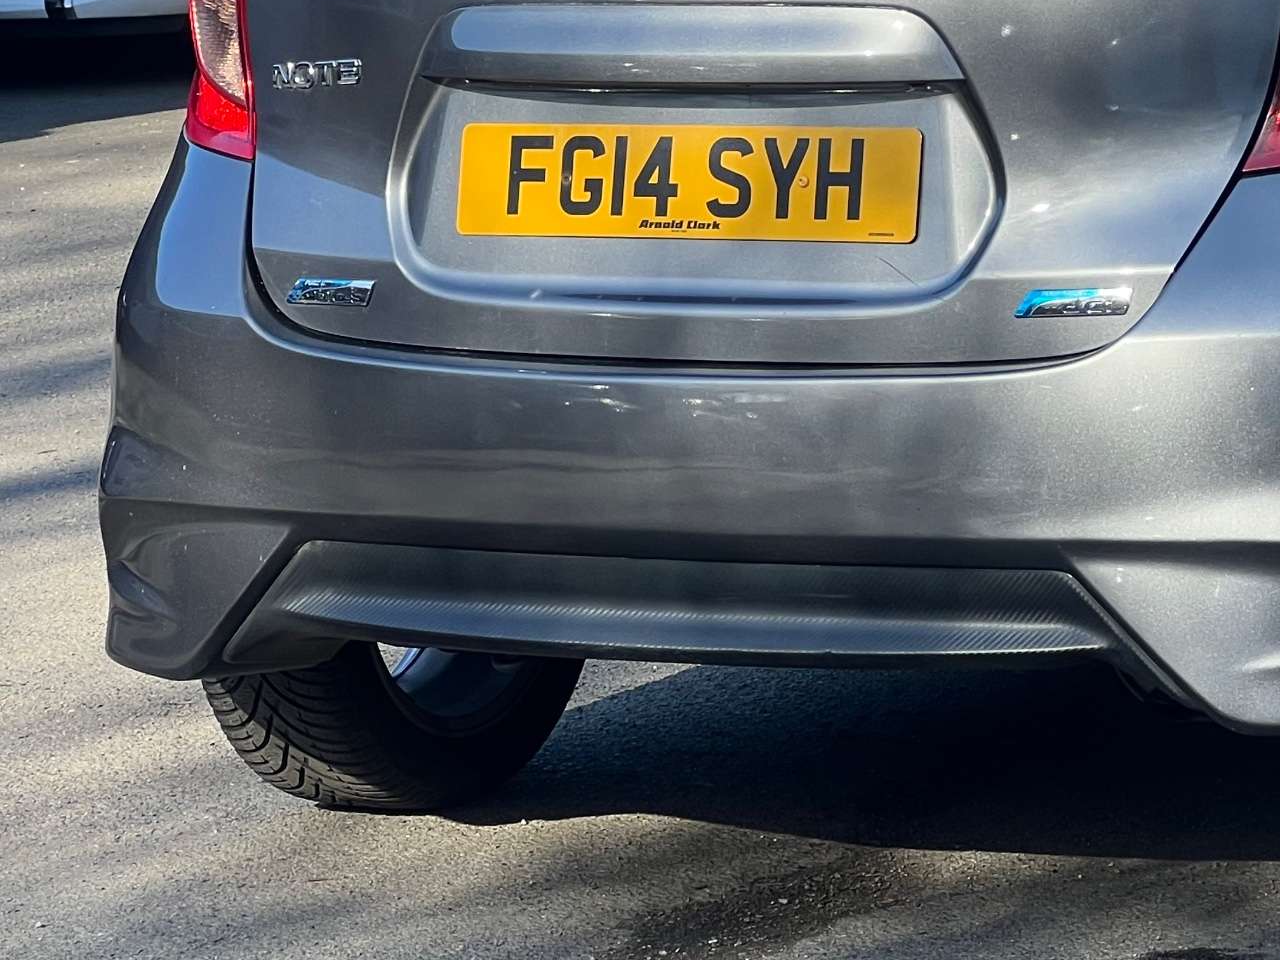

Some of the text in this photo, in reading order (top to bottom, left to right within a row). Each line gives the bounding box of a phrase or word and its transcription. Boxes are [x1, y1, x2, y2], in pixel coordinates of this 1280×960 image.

[272, 59, 362, 89] NOTE
[507, 135, 864, 220] FG14 SYH
[639, 219, 721, 230] Arnold Clark
